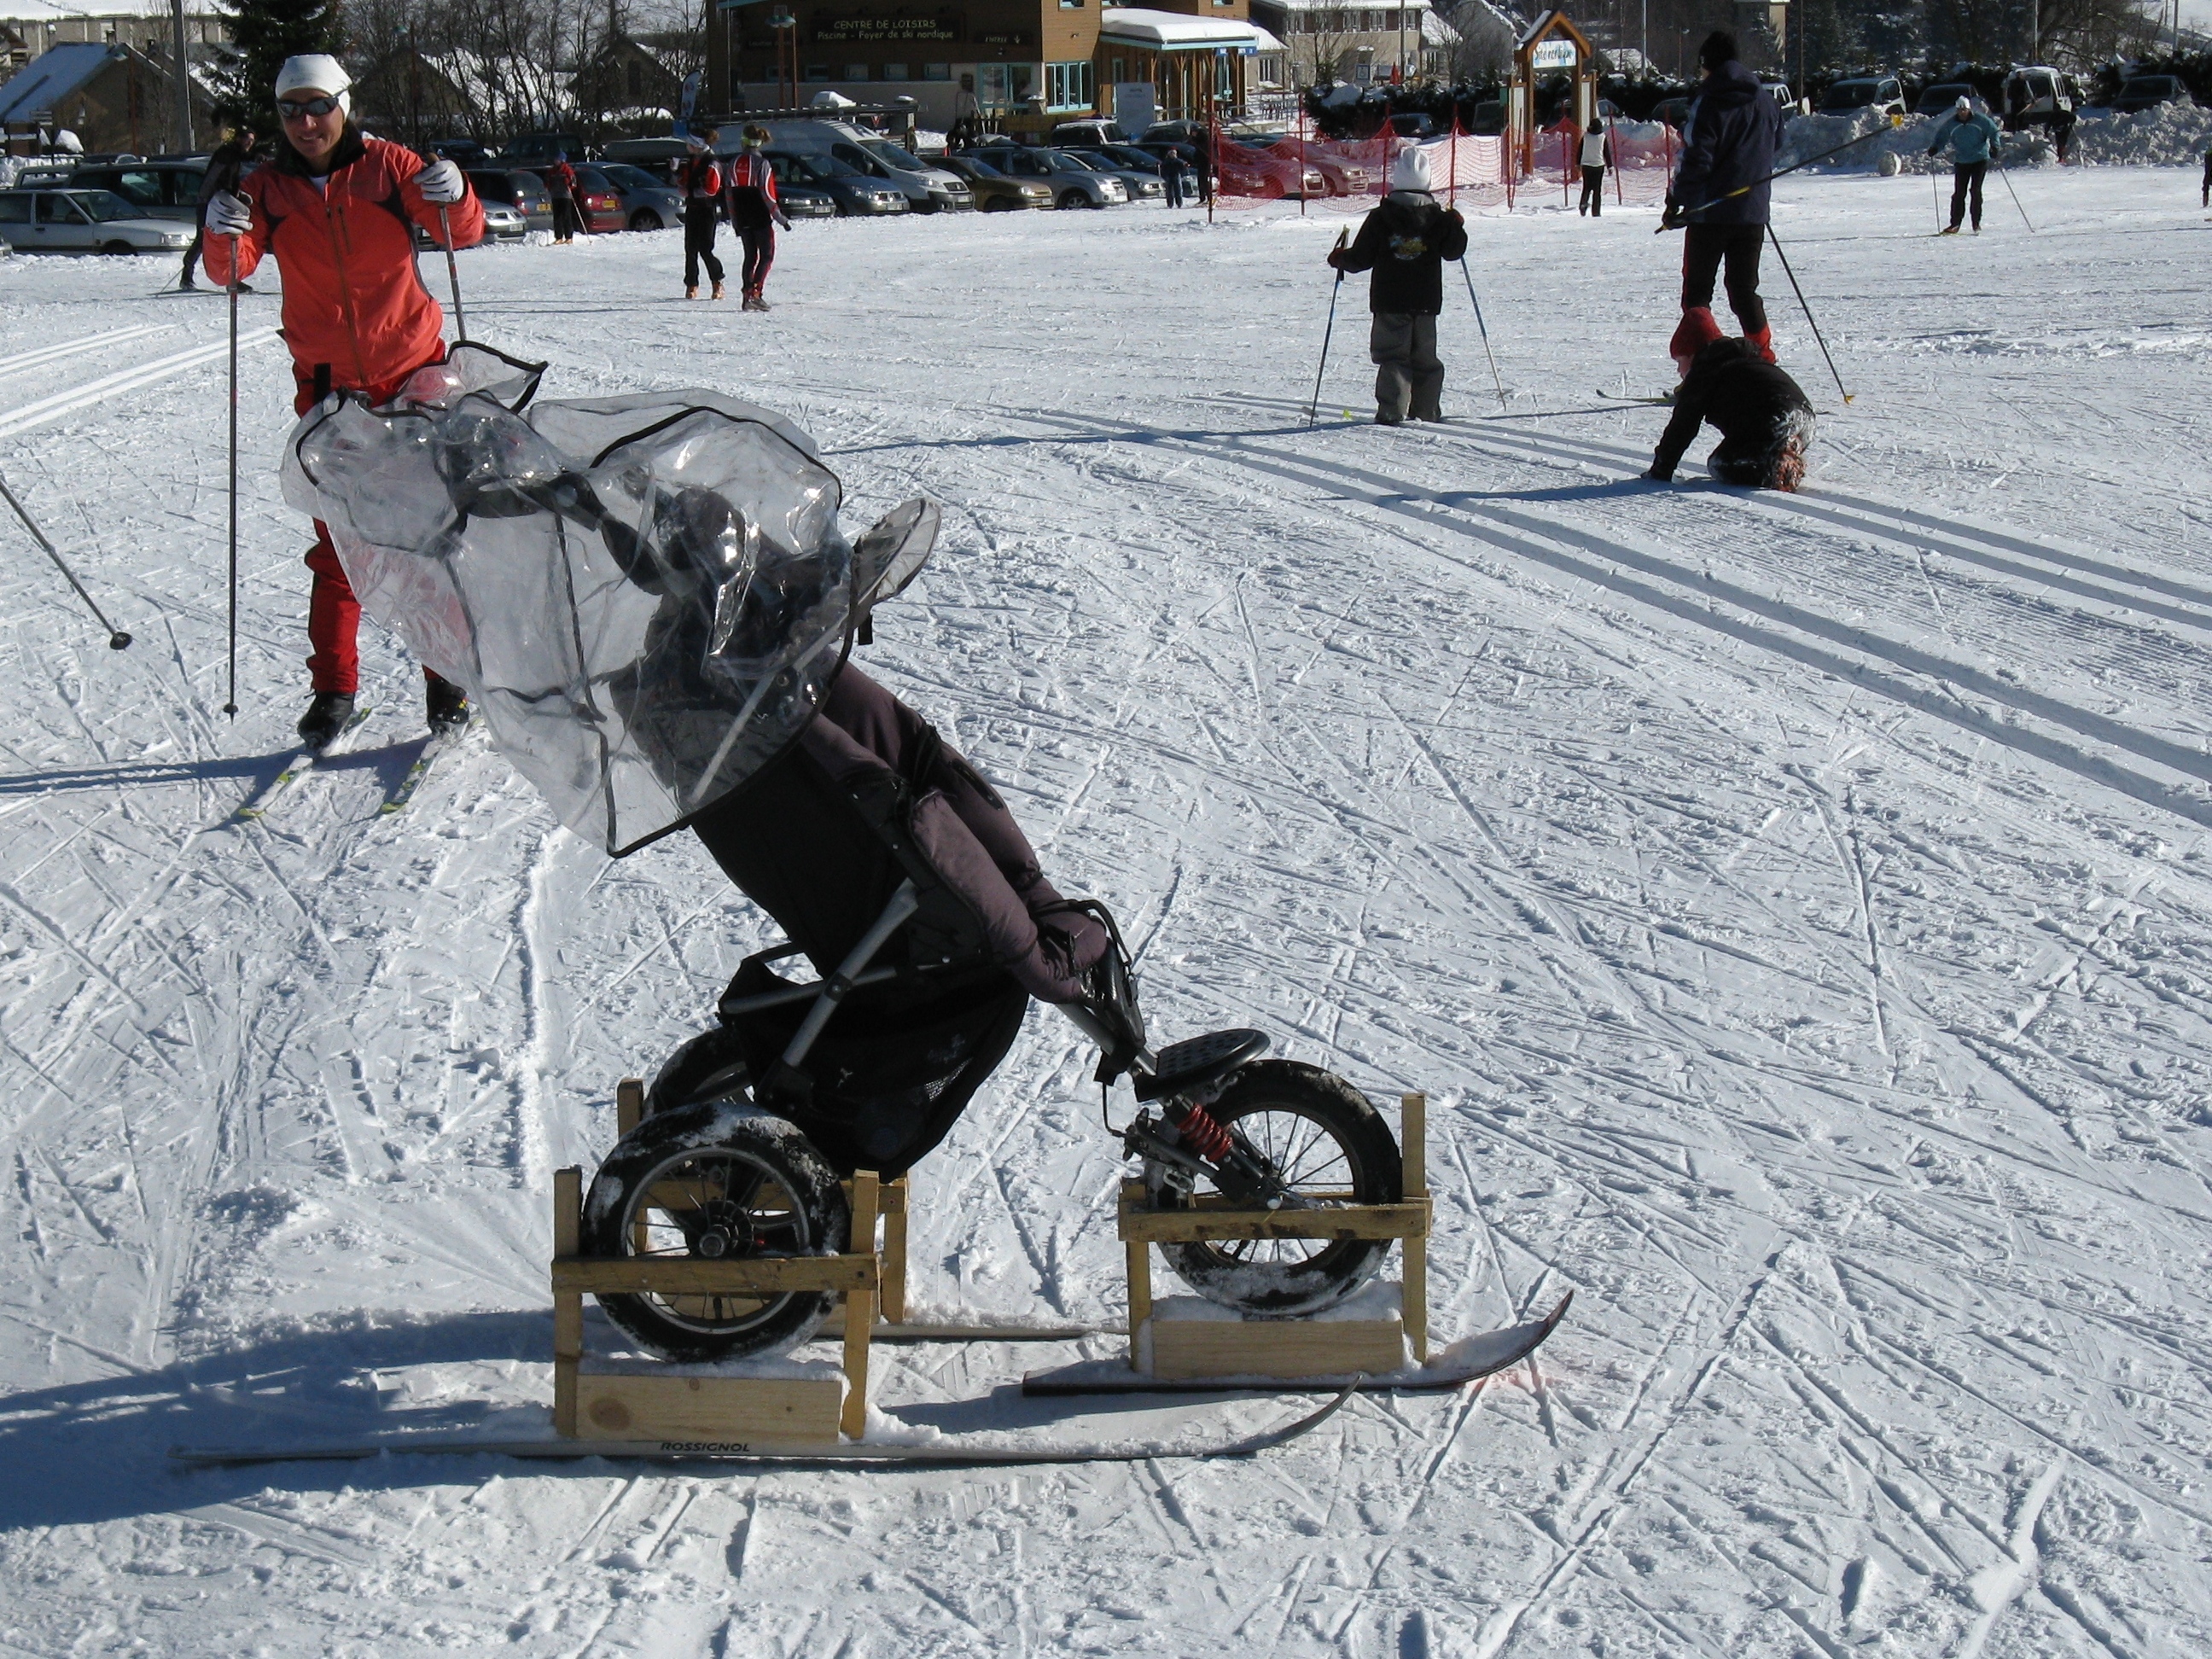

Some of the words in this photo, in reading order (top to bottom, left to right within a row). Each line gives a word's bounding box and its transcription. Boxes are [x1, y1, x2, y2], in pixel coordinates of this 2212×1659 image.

[834, 20, 872, 30] CENTRE
[876, 20, 889, 29] DE
[893, 20, 937, 29] LOISIRS
[818, 31, 847, 40] Piscine
[859, 30, 884, 41] Foyer
[888, 30, 899, 39] de
[902, 29, 913, 39] ski
[917, 29, 954, 40] nordique
[661, 1442, 750, 1452] ROSSIGNOL
